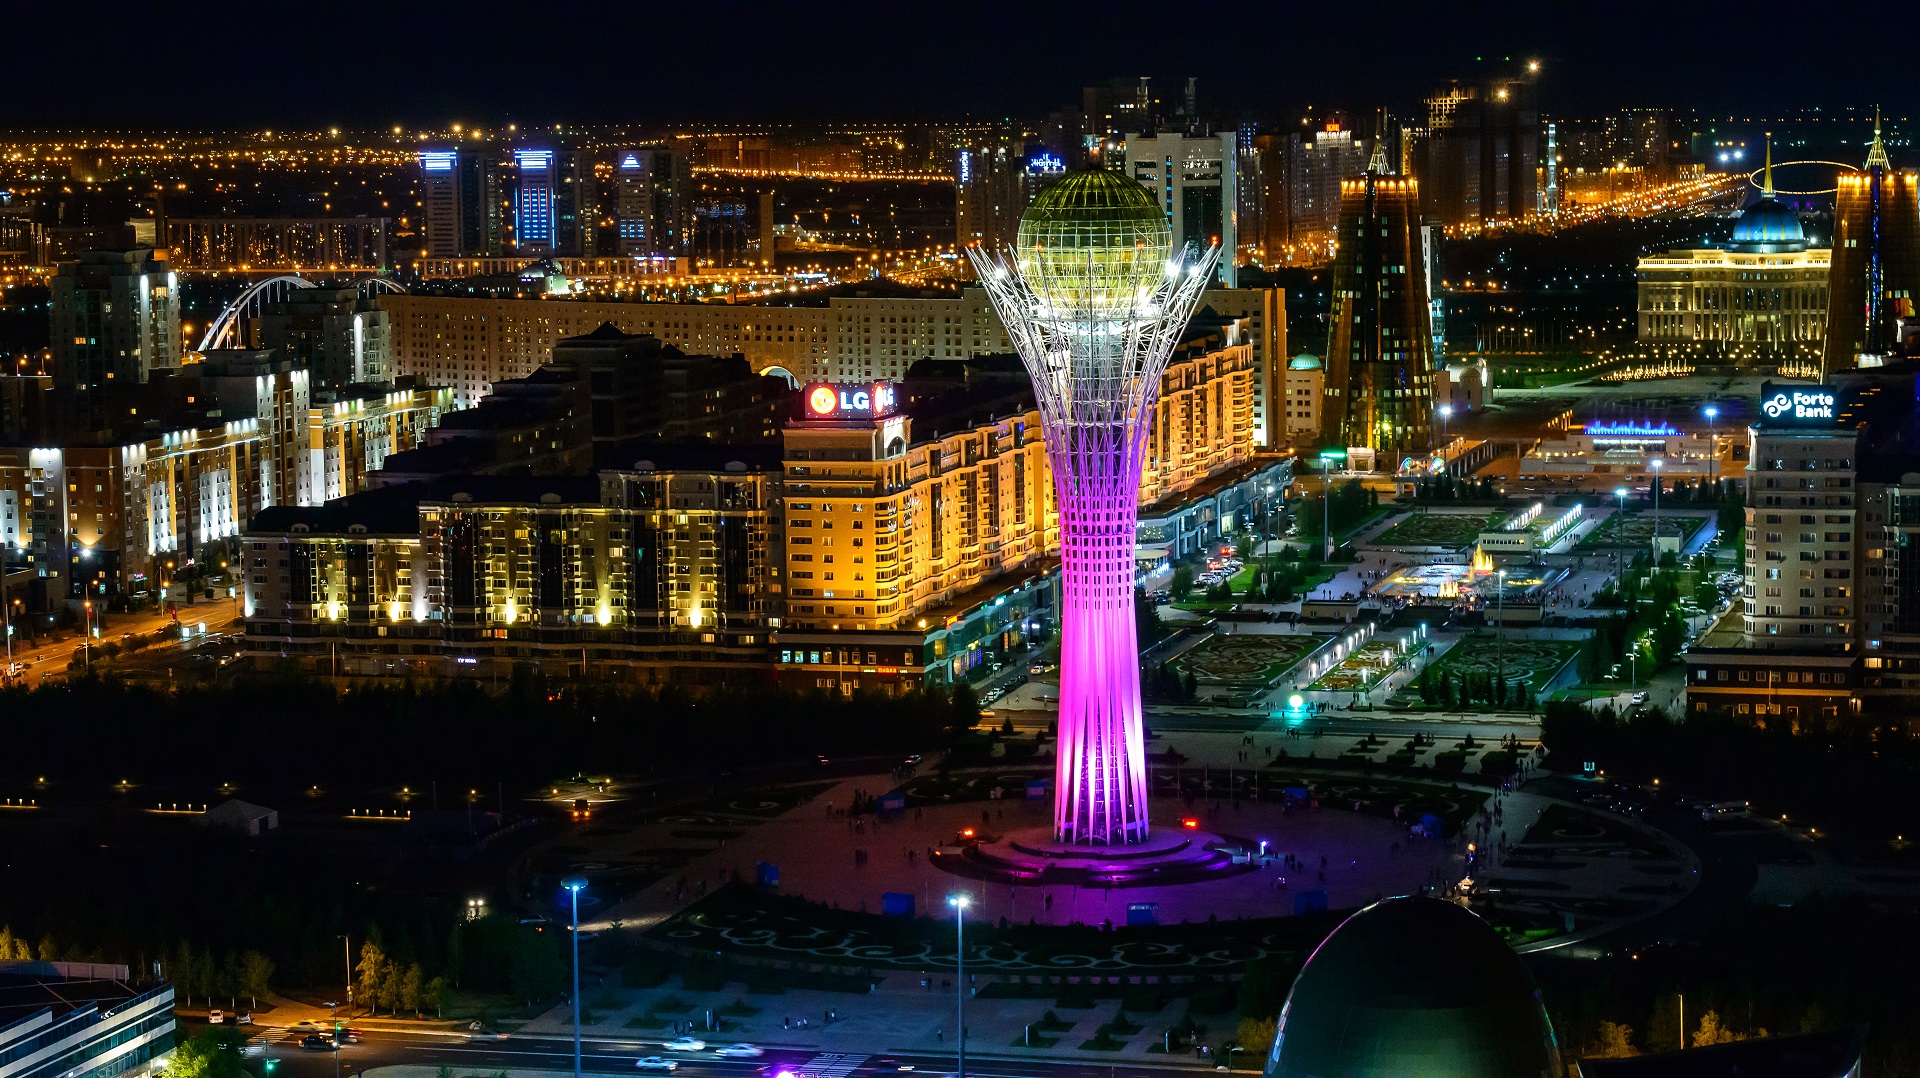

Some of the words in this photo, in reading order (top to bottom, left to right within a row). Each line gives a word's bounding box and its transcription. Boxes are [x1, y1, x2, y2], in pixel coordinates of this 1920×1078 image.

[961, 151, 969, 183] HIGHVILL
[840, 391, 870, 410] LG
[884, 387, 894, 407] LG
[1793, 392, 1834, 406] Forte
[1795, 405, 1832, 418] Bank
